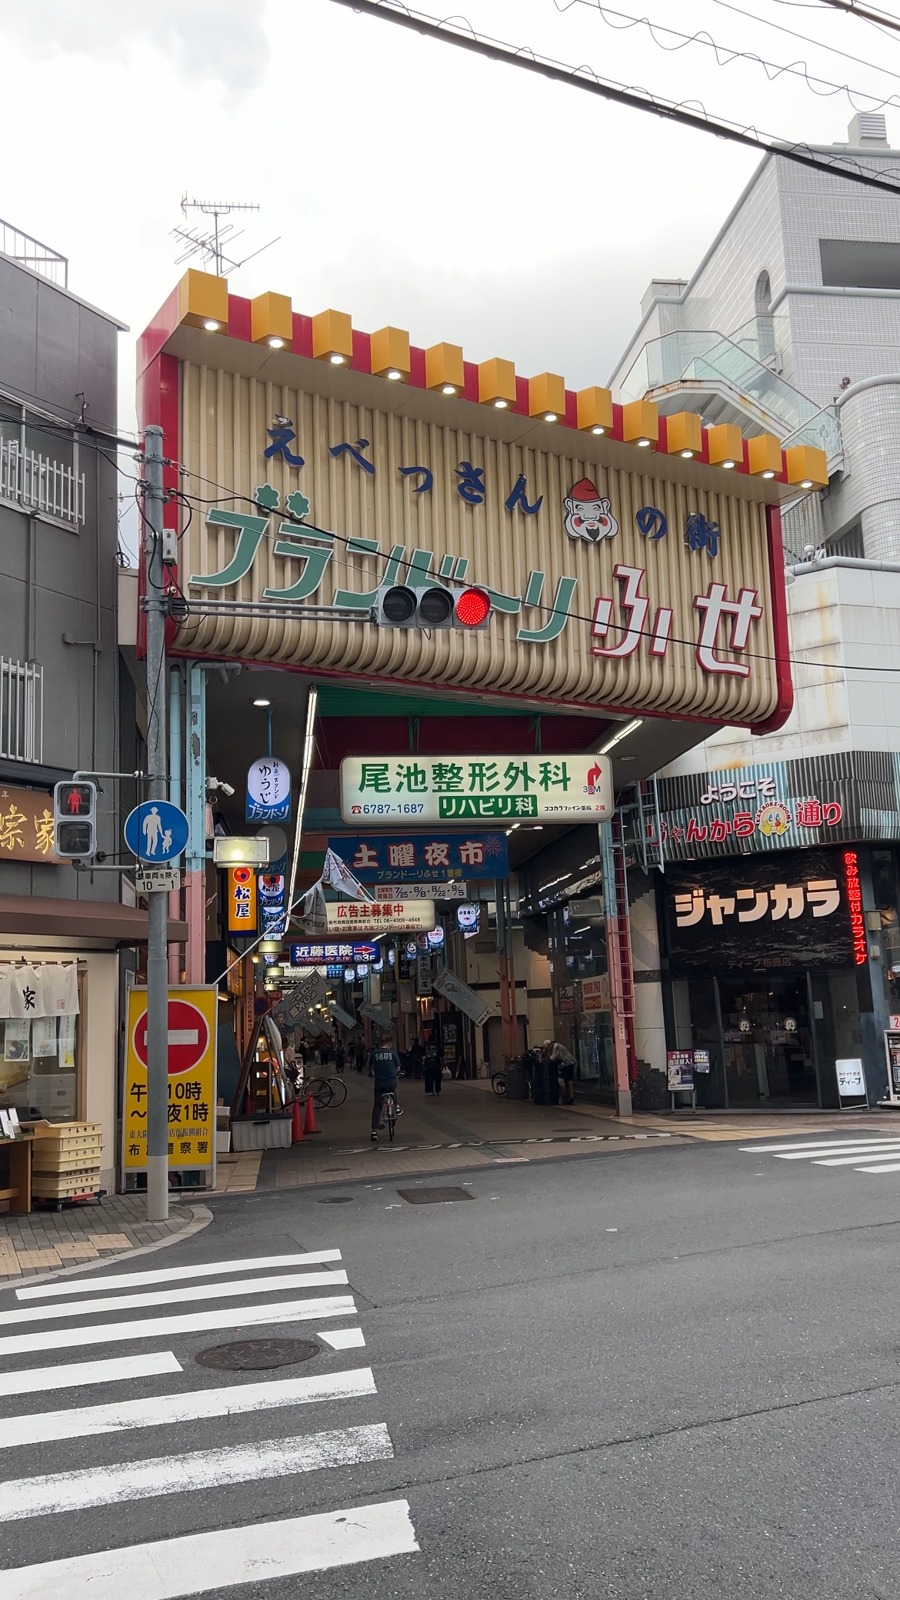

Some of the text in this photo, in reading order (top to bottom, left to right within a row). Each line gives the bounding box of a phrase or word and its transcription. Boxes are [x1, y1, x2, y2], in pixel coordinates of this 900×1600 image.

[258, 764, 271, 804] ゆうじ
[357, 761, 571, 793] 尾池整形外科
[700, 777, 776, 804] ようこそ
[363, 803, 424, 814] 6787-1687
[441, 797, 534, 816] リハビリ科
[795, 799, 842, 828] 通り
[353, 842, 486, 869] 土曜夜市
[234, 886, 251, 918] 松屋
[336, 903, 404, 918] 広告主募集中
[675, 879, 840, 928] ジャンカラ
[844, 852, 868, 966] 飲み放題付カラオケ
[295, 945, 353, 957] 近藤医院
[362, 954, 376, 962] 3F
[22, 985, 36, 1011] 家
[130, 1081, 202, 1102] 午10時
[130, 1102, 209, 1123] ～夜1時
[128, 1141, 209, 1156] 布警察署
